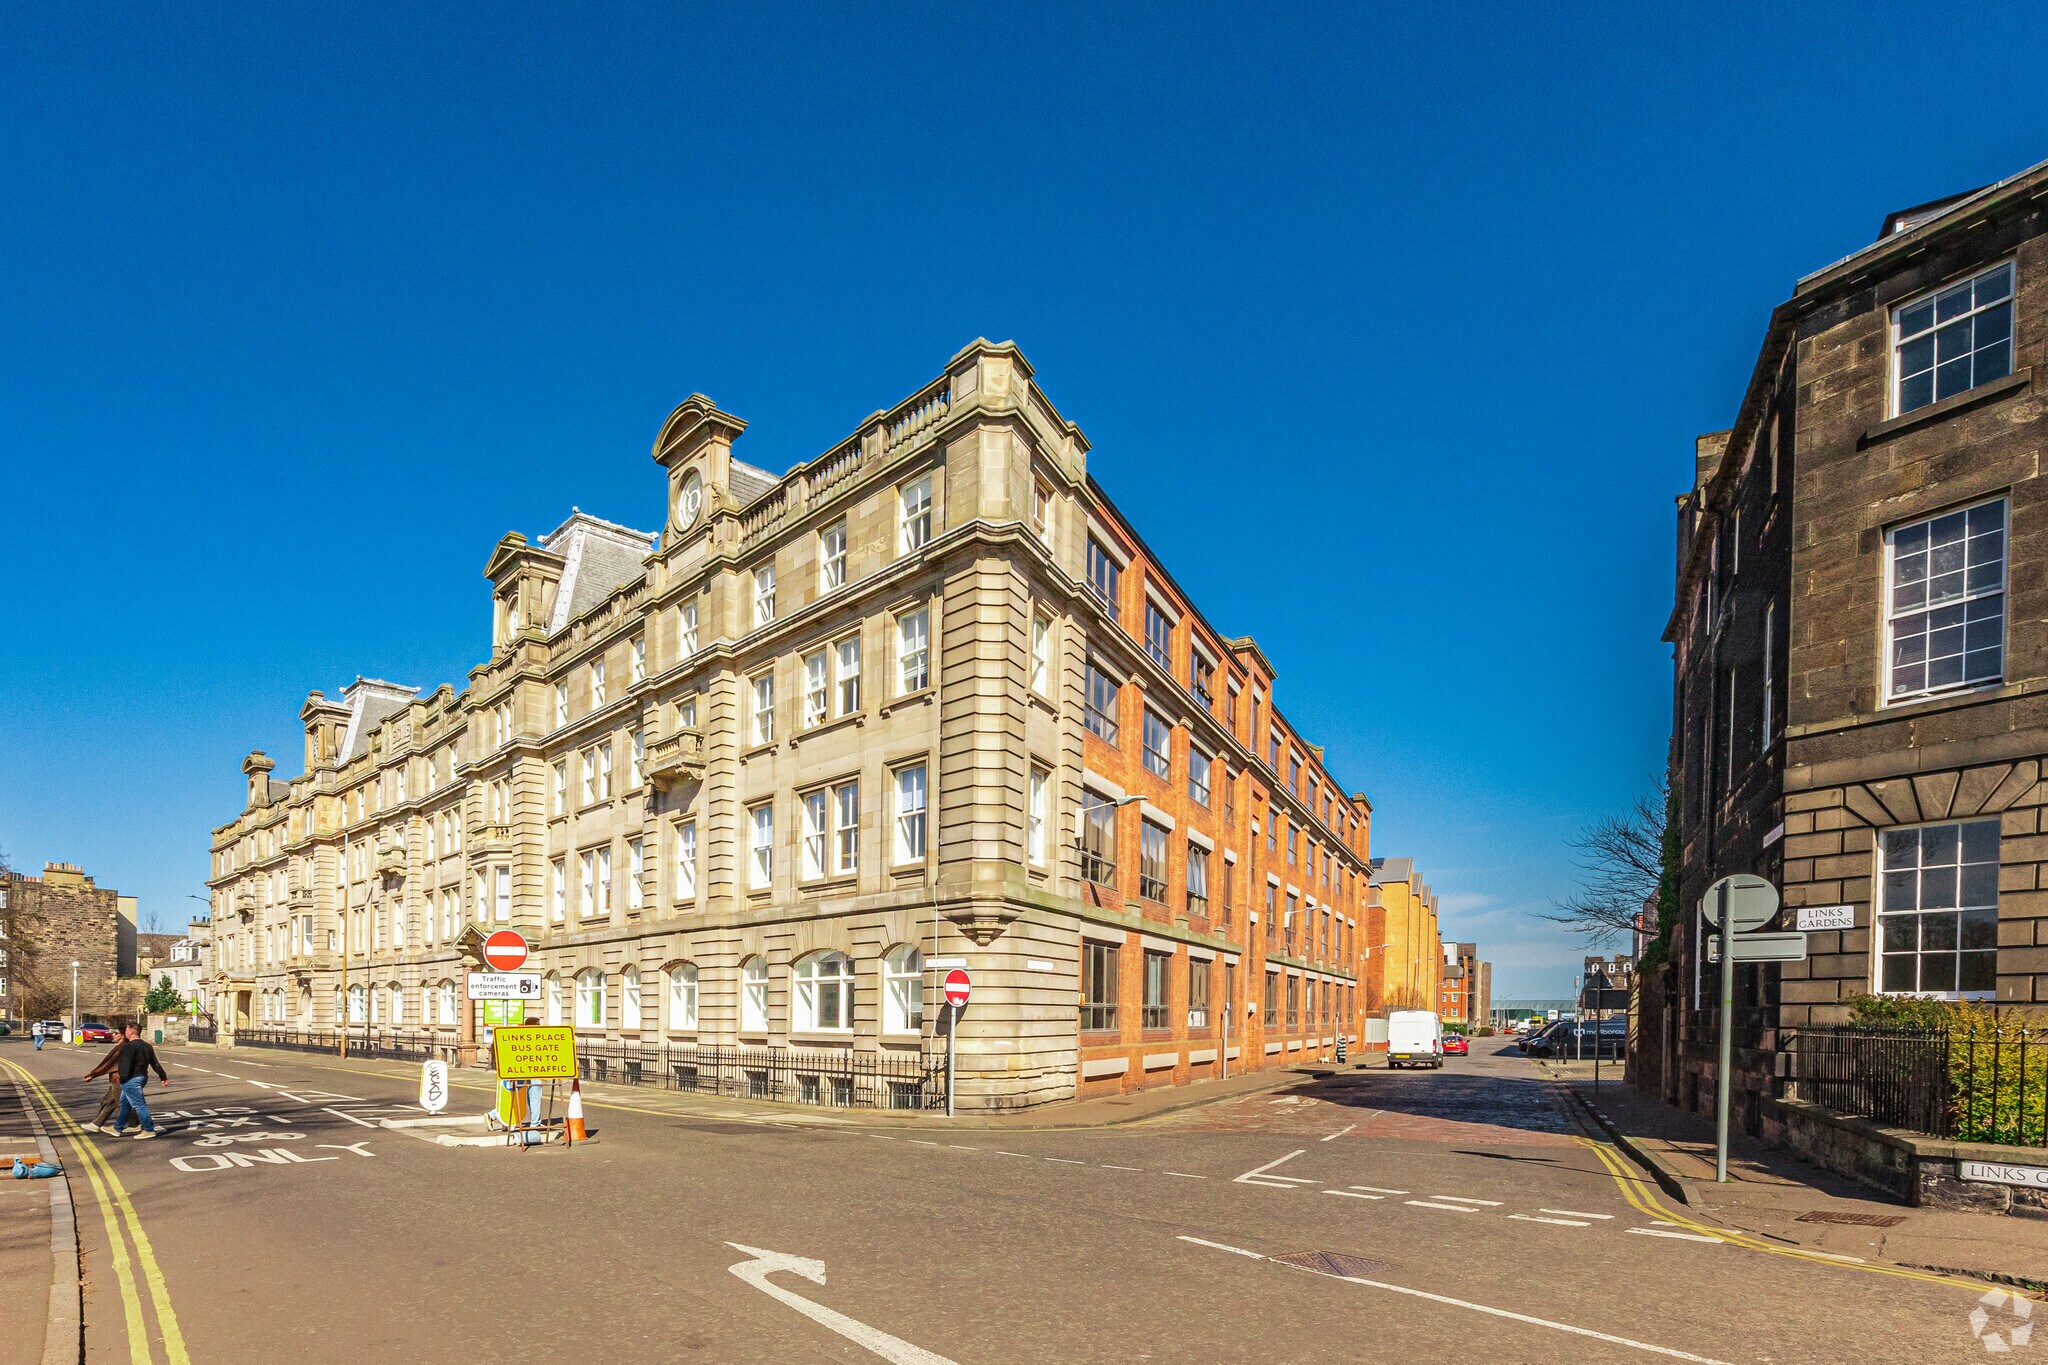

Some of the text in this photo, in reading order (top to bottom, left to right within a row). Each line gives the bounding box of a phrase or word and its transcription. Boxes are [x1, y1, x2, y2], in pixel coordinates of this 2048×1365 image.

[1808, 907, 1843, 918] LINKS
[1798, 917, 1853, 929] GARDENS
[482, 975, 506, 983] Traffic
[502, 1033, 566, 1042] LINKS PLACE
[511, 1044, 560, 1052] BUS GATE
[515, 1054, 558, 1062] OPEN TO
[507, 1065, 567, 1074] ALL TRAFFIC
[169, 1141, 376, 1172] ONLY
[1970, 1164, 2026, 1181] LINKS
